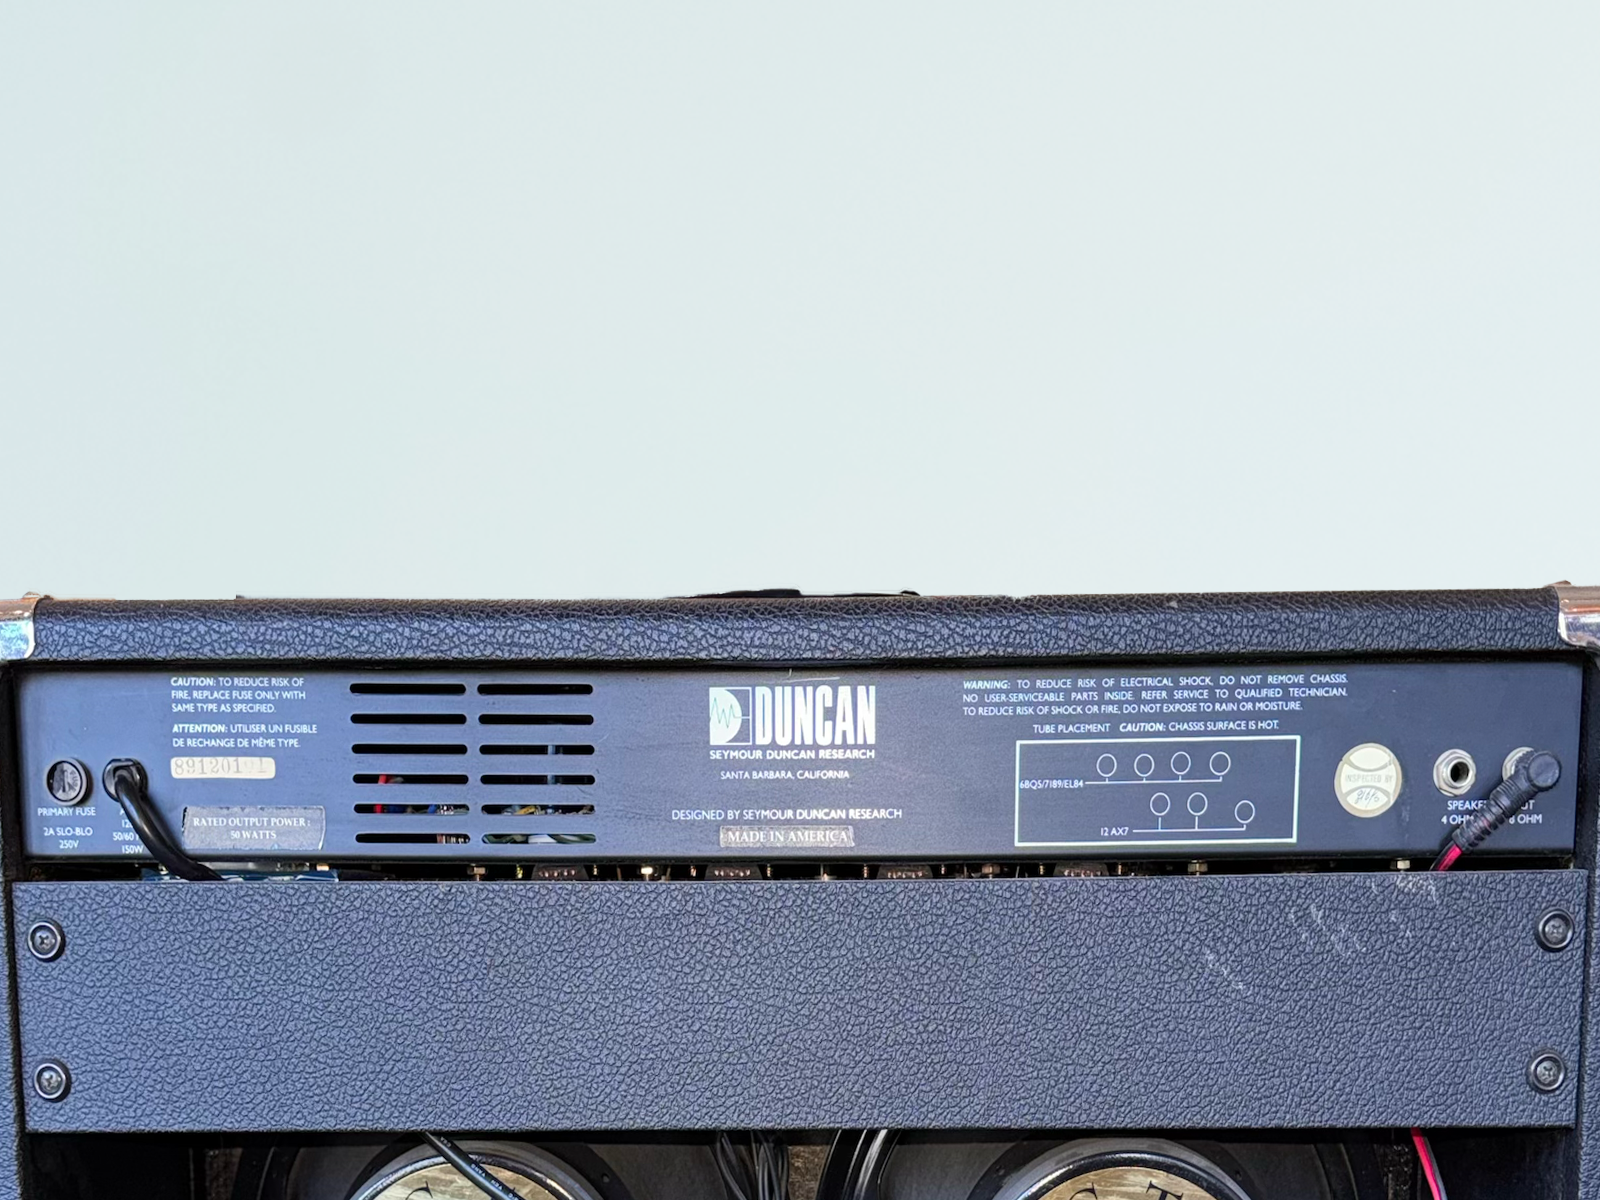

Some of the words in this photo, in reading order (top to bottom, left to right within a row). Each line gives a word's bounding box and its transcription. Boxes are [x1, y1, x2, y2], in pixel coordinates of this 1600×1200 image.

[170, 677, 216, 687] CAUTION:
[219, 677, 232, 687] TO
[233, 677, 269, 687] REDUCE
[271, 678, 290, 687] RISK
[291, 678, 304, 687] OF
[963, 680, 1011, 689] WARNING:
[1017, 679, 1031, 689] TO
[1036, 679, 1072, 688] REDUCE
[1078, 679, 1097, 688] RISK
[1102, 678, 1115, 687] OF
[1120, 677, 1174, 687] ELECTRICAL
[1219, 676, 1235, 685] DO
[1240, 675, 1262, 685] NOT
[1267, 675, 1305, 684] REMOVE
[1310, 674, 1348, 683] CHASSIS.
[171, 690, 191, 700] FIRE,
[193, 690, 230, 700] REPLACE
[232, 690, 253, 700] FUSE
[254, 690, 280, 700] ONLY
[281, 690, 306, 700] WITH
[963, 694, 978, 703] NO
[984, 692, 1065, 702] USER-SERVICEABLE
[1071, 692, 1098, 701] PARTS
[1142, 690, 1168, 700] REFER
[1173, 689, 1209, 699] SERVICE
[1214, 689, 1229, 698] TO
[1234, 688, 1283, 699] QUALIFIED
[1288, 687, 1348, 697] TECHNICIAN.
[171, 703, 195, 713] SAME
[196, 703, 218, 713] TYPE
[219, 703, 231, 713] AS
[232, 703, 276, 713] SPECIFIED.
[963, 706, 977, 715] TO
[978, 706, 1014, 716] REDUCE
[1016, 706, 1034, 715] RISK
[1036, 706, 1050, 715] OF
[1051, 705, 1083, 715] SHOCK
[1085, 705, 1099, 714] OR
[1101, 705, 1121, 715] FIRE,
[1123, 704, 1138, 714] DO
[1140, 704, 1161, 713] NOT
[1163, 703, 1197, 712] EXPOSE
[1199, 703, 1213, 712] TO
[1215, 702, 1238, 711] RAIN
[1239, 702, 1254, 711] OR
[1255, 701, 1303, 711] MOISTURE.
[755, 685, 876, 745] DUNCAN
[172, 724, 228, 733] ATTENTION:
[230, 724, 266, 733] UTILISER
[268, 724, 282, 733] UN
[284, 724, 317, 733] FUSIBLE
[1033, 724, 1055, 733] TUBE
[1058, 723, 1111, 733] PLACEMENT
[1119, 722, 1166, 732] CAUTION:
[1168, 722, 1205, 731] CHASSIS
[1206, 721, 1246, 730] SURFACE
[1249, 721, 1256, 730] IS
[1257, 720, 1279, 730] HOT.
[172, 738, 185, 747] DE
[186, 738, 235, 747] RECHANGE
[237, 738, 249, 747] DE
[251, 736, 276, 747] MÊME
[277, 738, 301, 747] TYPE.
[710, 750, 763, 760] SEYMOUR
[766, 750, 815, 759] DUNCAN
[819, 749, 875, 759] RESEARCH
[721, 770, 750, 780] SANTA
[752, 770, 795, 780] BARBARA,
[797, 770, 850, 779] CALIFORNIA
[1345, 774, 1381, 783] INSPECTED
[1384, 774, 1393, 783] BY
[1019, 779, 1083, 790] 6BQ5/7189/EL84
[37, 807, 73, 816] PRIMARY
[76, 807, 96, 816] FUSE
[672, 810, 724, 820] DESIGNED
[727, 810, 740, 820] BY
[743, 810, 794, 820] SEYMOUR
[796, 809, 847, 819] DUNCAN
[849, 809, 902, 819] RESEARCH
[193, 817, 227, 827] RATED
[228, 817, 269, 827] OUTPUT
[1441, 815, 1447, 824] 4
[1517, 814, 1542, 824] OHM
[43, 828, 54, 836] 2A
[57, 827, 93, 836] SLO-BLO
[113, 832, 134, 841] 50/60
[230, 831, 241, 839] 50
[242, 830, 277, 839] WATTS
[727, 831, 767, 842] MADE
[770, 831, 784, 842] IN
[789, 830, 847, 842] AMERICA
[1100, 827, 1109, 836] 12
[1110, 827, 1129, 836] AX7
[59, 840, 79, 849] 250V
[122, 845, 144, 854] 150W
